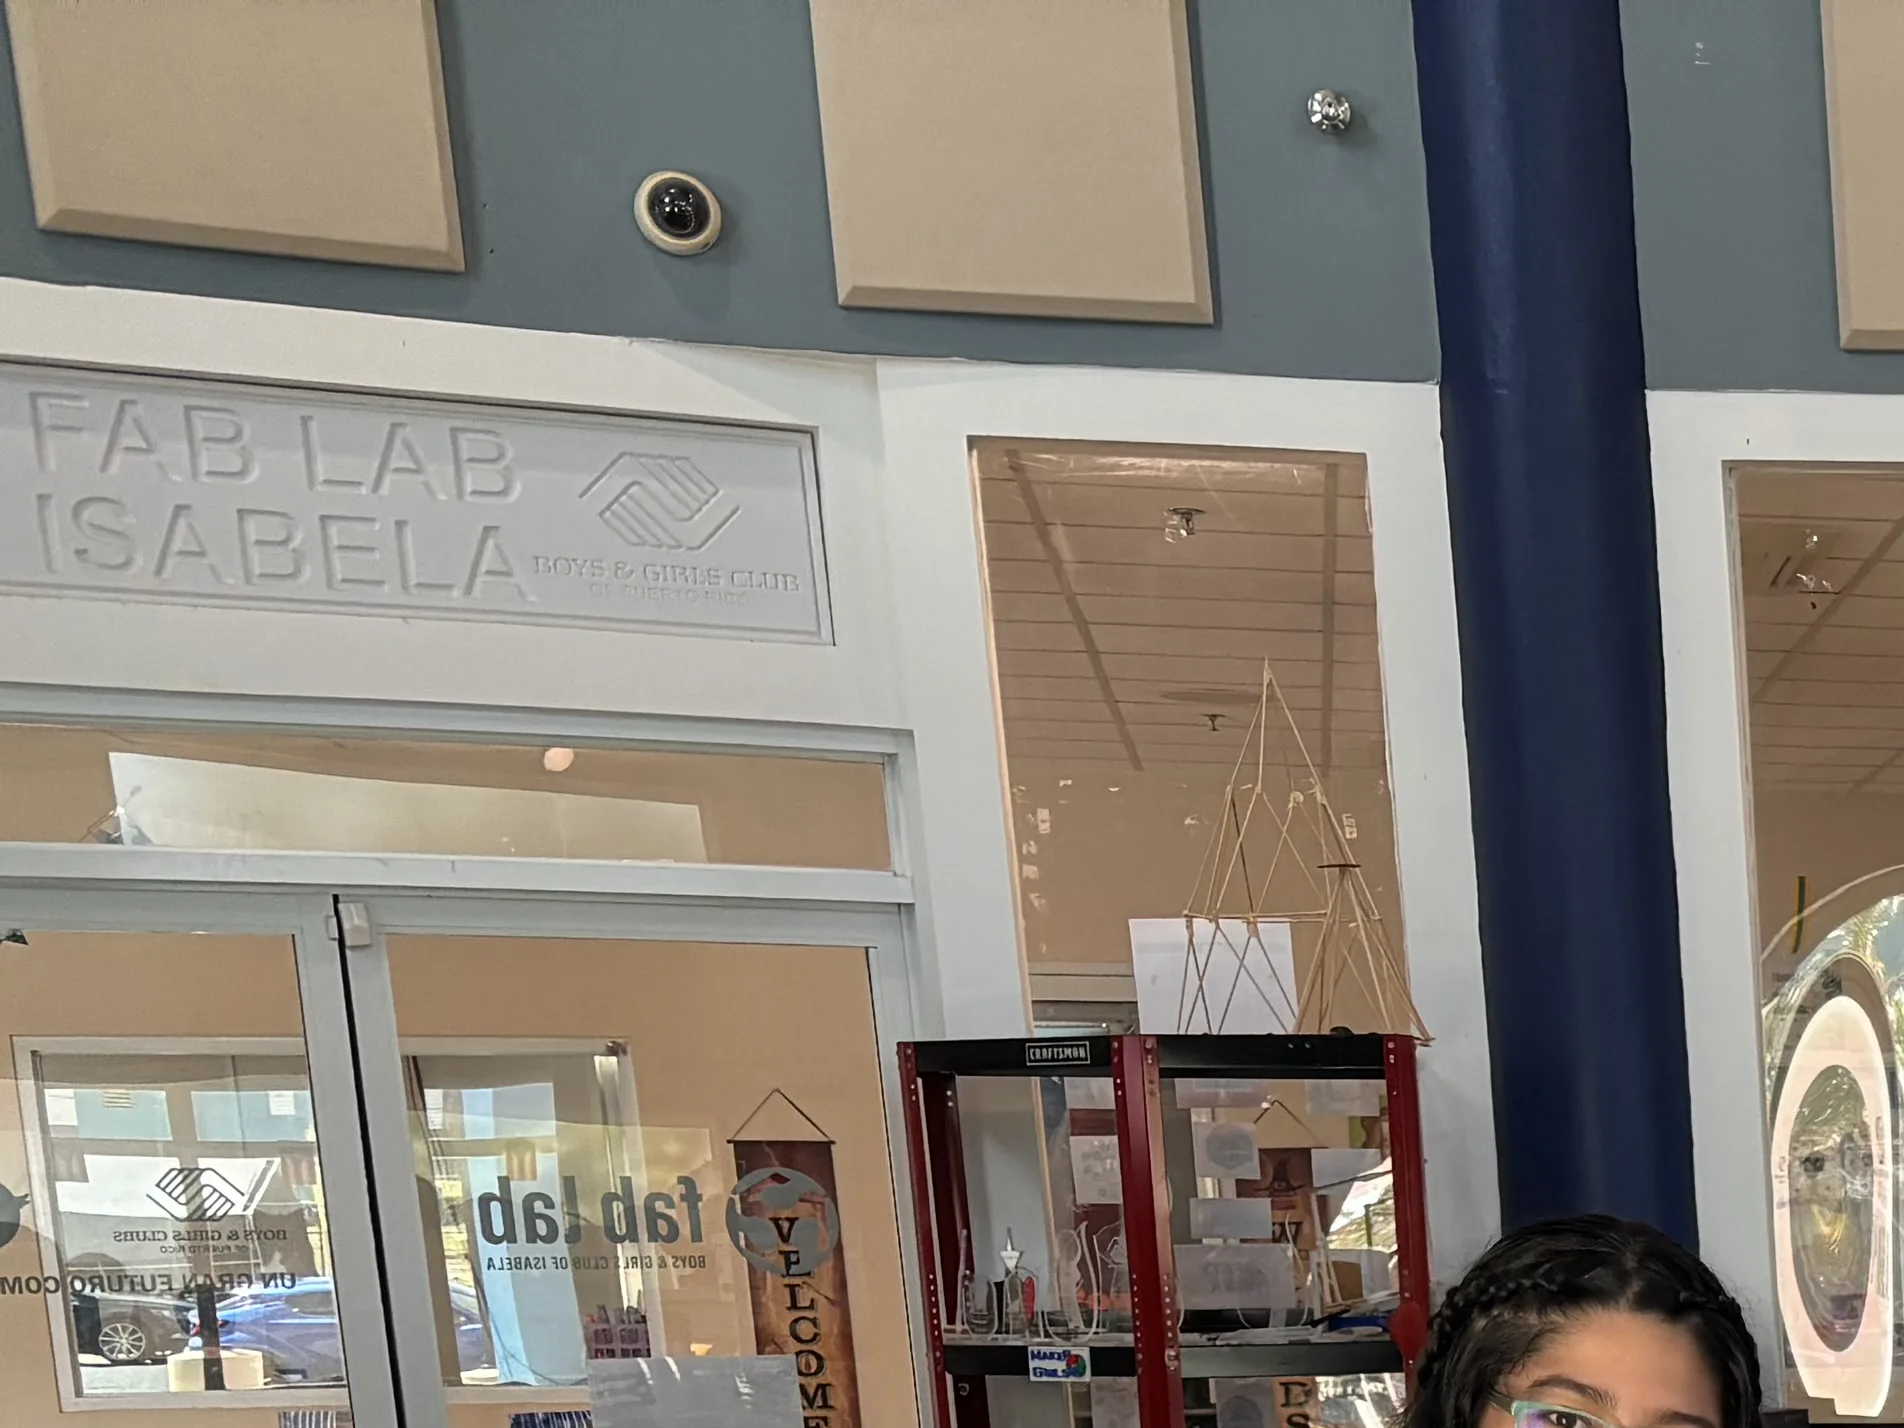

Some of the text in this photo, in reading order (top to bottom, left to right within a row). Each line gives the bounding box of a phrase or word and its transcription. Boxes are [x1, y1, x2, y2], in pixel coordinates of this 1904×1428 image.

[28, 391, 522, 503] FAB LAB
[36, 493, 540, 601] ISABELA
[533, 555, 604, 578] BOYS
[613, 560, 634, 580] &
[643, 563, 723, 587] GIRLS
